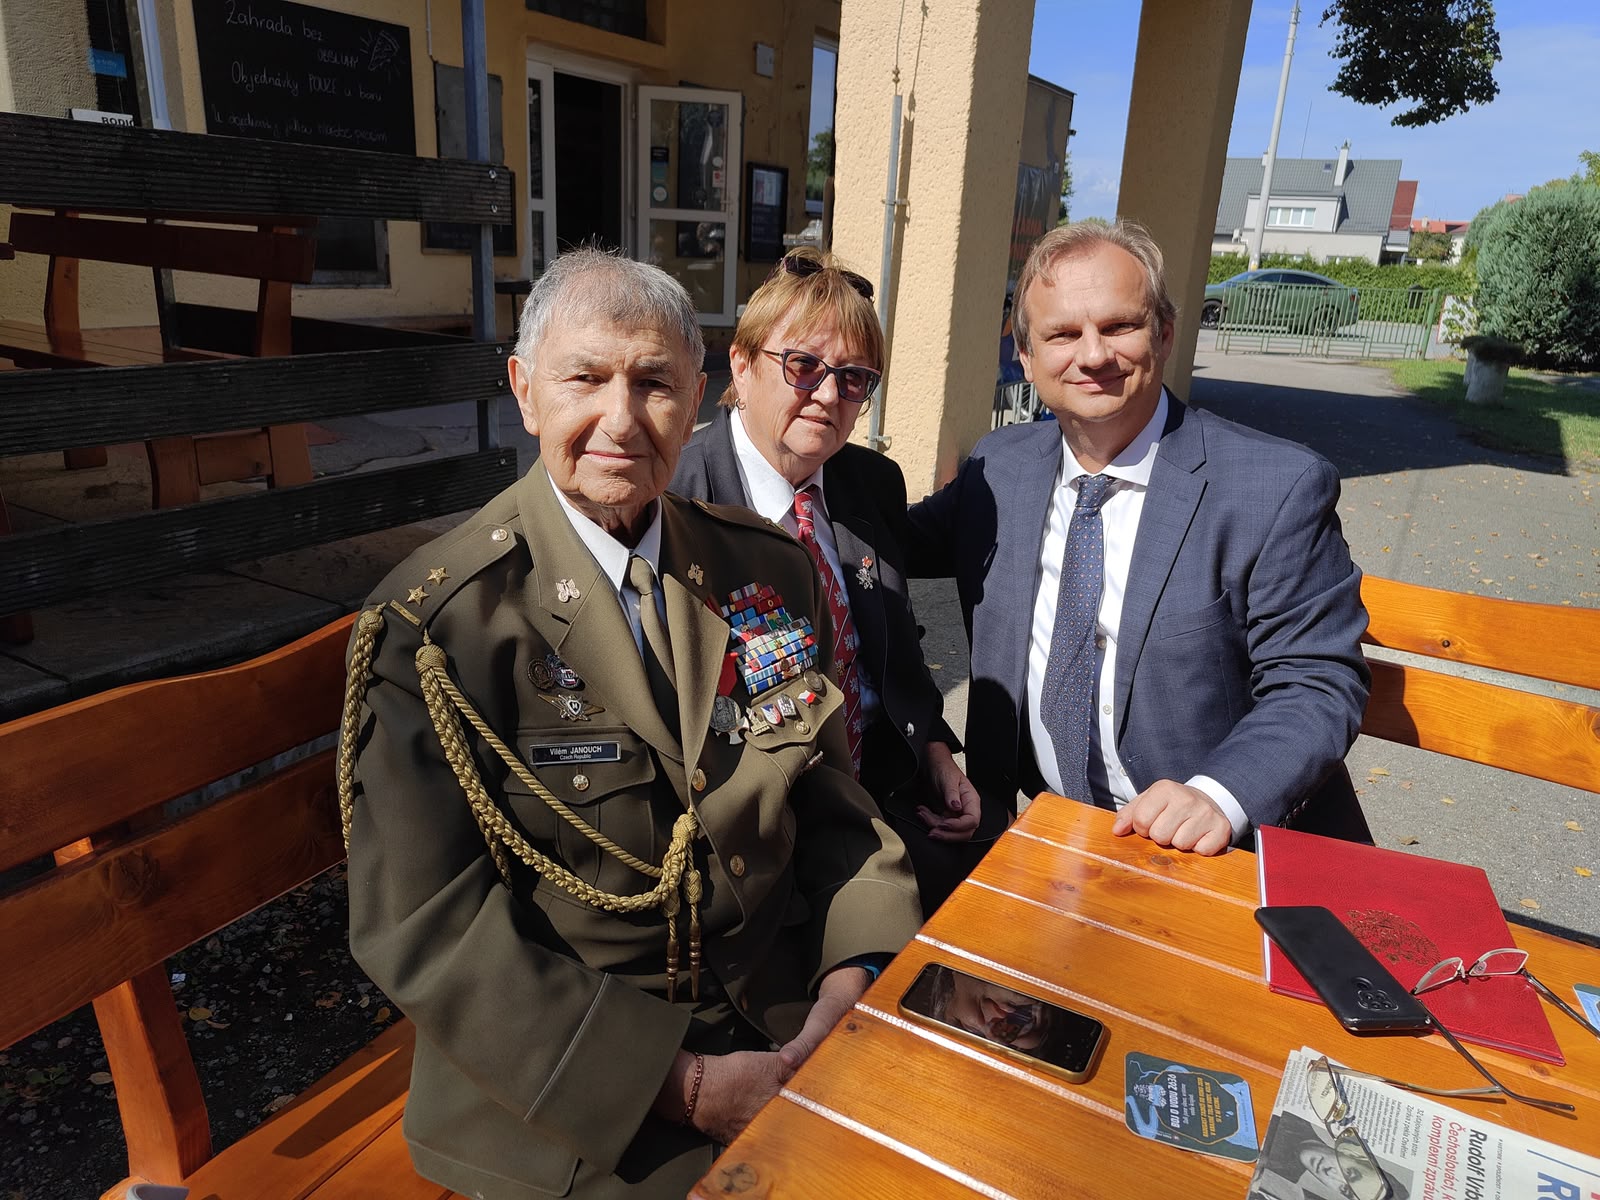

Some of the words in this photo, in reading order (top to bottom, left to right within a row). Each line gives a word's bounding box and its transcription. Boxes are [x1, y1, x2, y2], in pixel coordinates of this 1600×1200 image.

[226, 0, 293, 36] Zahrada
[303, 19, 324, 42] bez
[231, 60, 299, 97] Objednávky
[308, 72, 337, 95] POUZE
[549, 748, 568, 756] Vilém
[570, 745, 602, 754] JANOUCH
[1169, 1090, 1179, 1109] VODU
[1170, 1114, 1180, 1128] BOJ
[1427, 1115, 1446, 1170] komplexní
[1441, 1121, 1466, 1192] Čechoslováci,
[1466, 1129, 1487, 1178] Rudolf
[1464, 1175, 1485, 1200] Vrb
